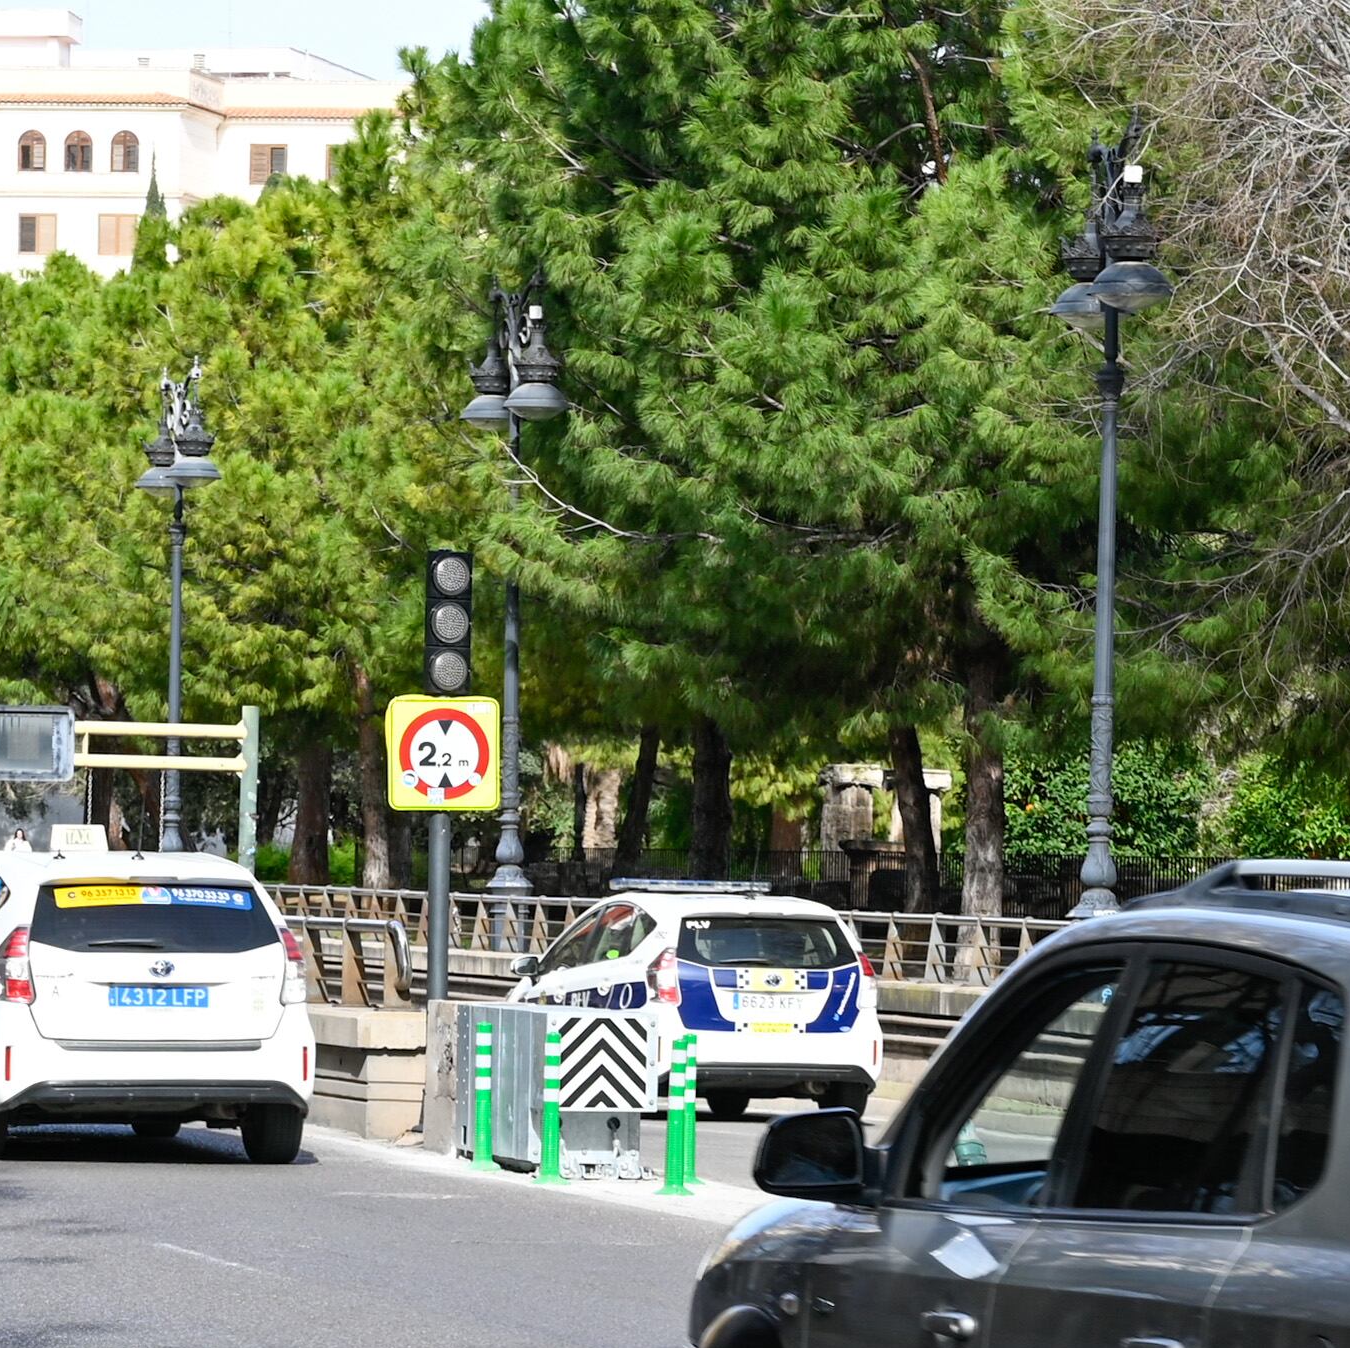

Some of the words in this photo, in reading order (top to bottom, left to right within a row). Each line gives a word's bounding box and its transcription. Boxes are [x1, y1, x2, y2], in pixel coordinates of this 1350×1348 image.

[120, 989, 166, 1006] 4312
[172, 990, 206, 1007] LFP
[742, 996, 774, 1009] 6623
